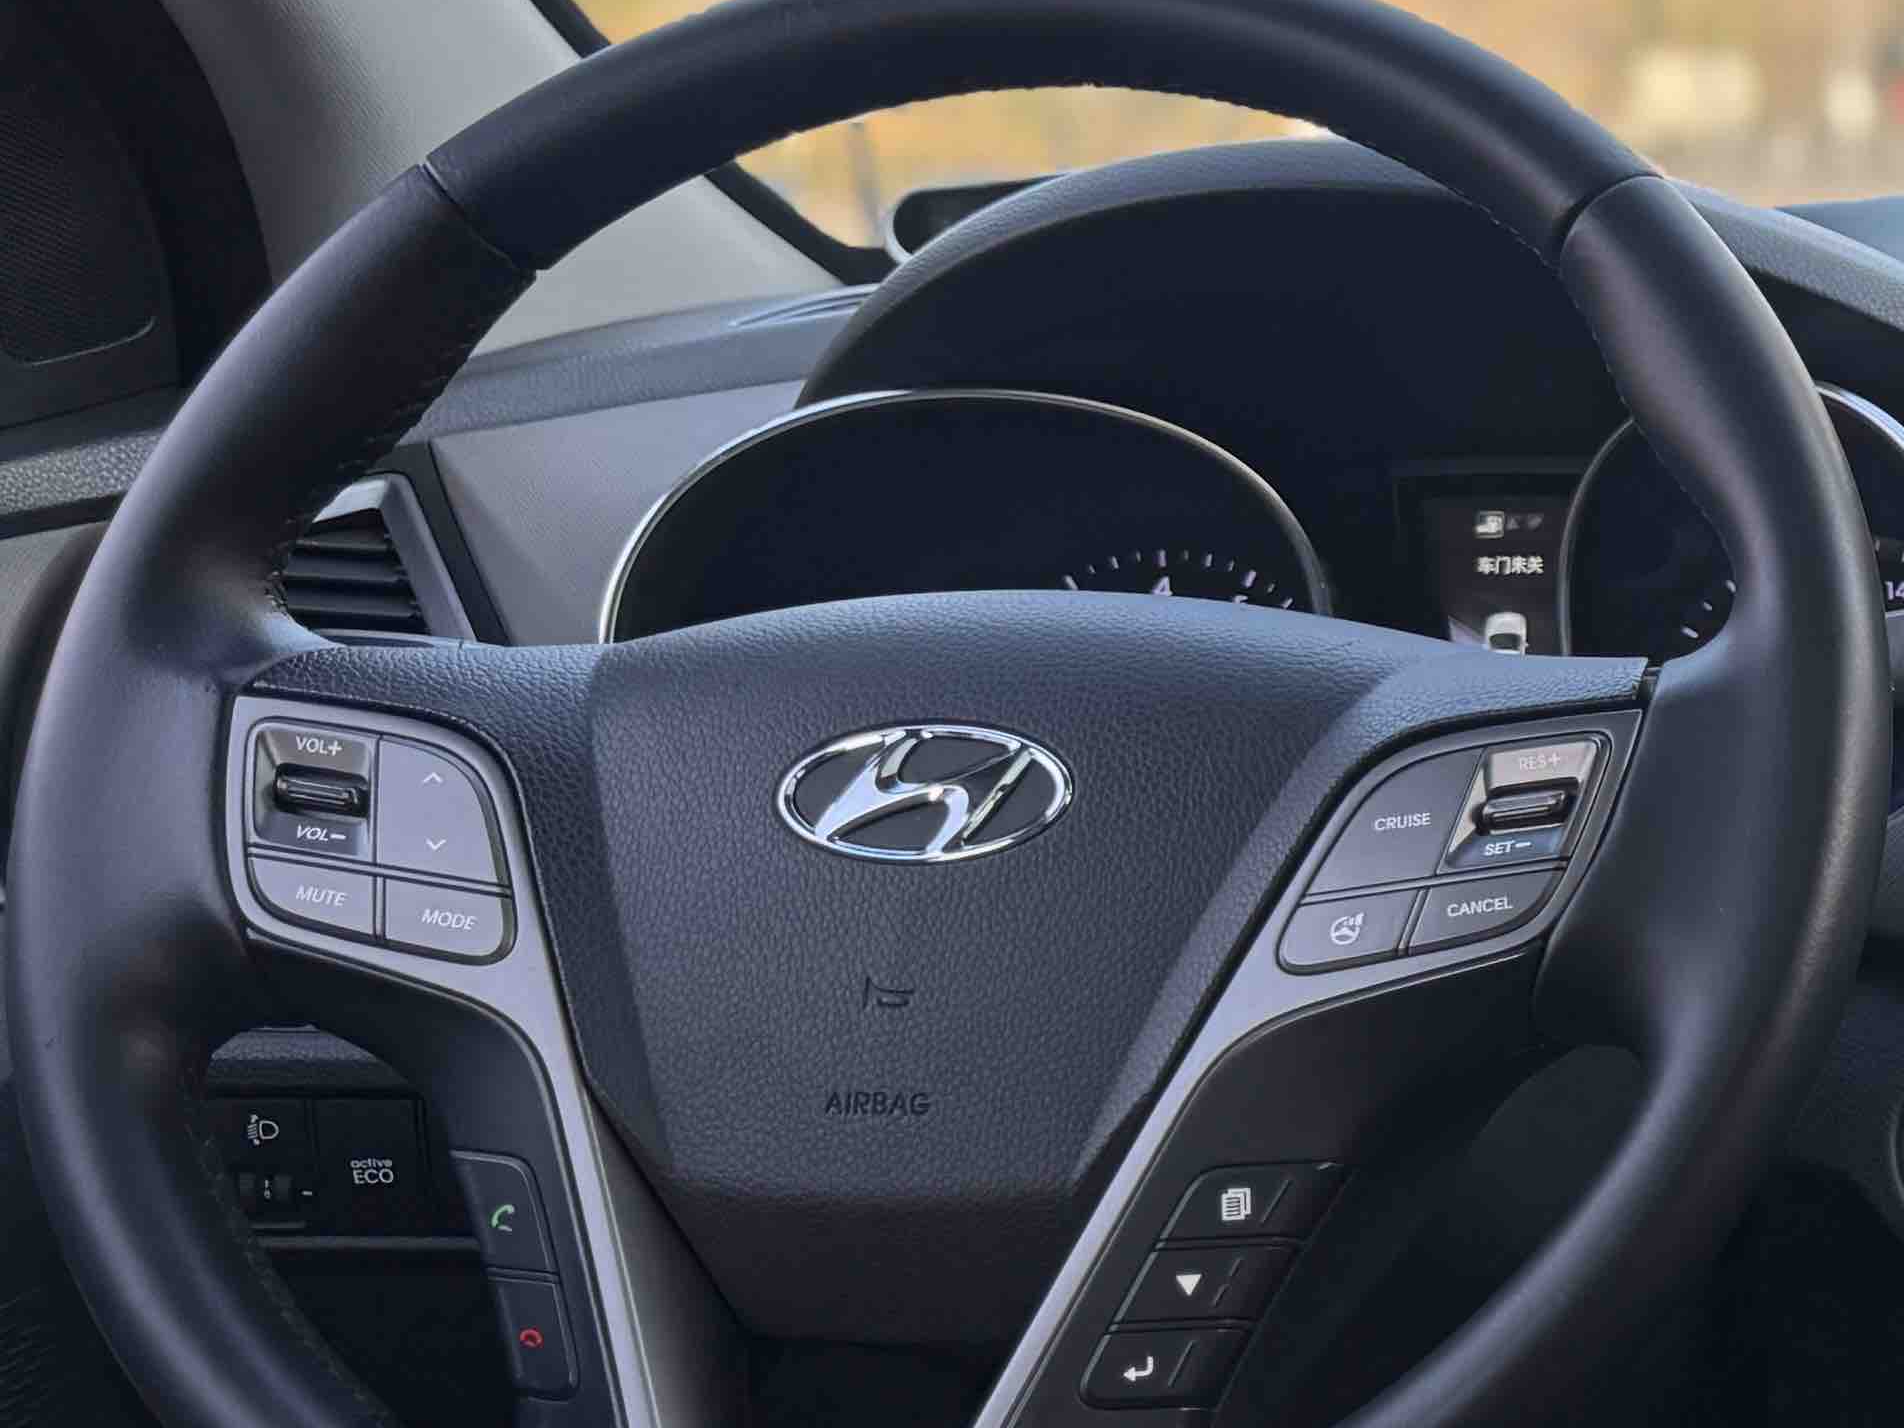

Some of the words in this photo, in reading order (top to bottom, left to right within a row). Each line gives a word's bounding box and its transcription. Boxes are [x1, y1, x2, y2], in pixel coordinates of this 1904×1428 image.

[295, 735, 343, 757] VOL+
[1374, 812, 1432, 832] CRUISE
[295, 885, 348, 907] MUTE
[1446, 896, 1514, 918] CANCEL
[421, 908, 478, 931] MODE
[824, 1091, 930, 1115] AIRBAG
[349, 1158, 393, 1170] active
[351, 1169, 395, 1185] ECO
